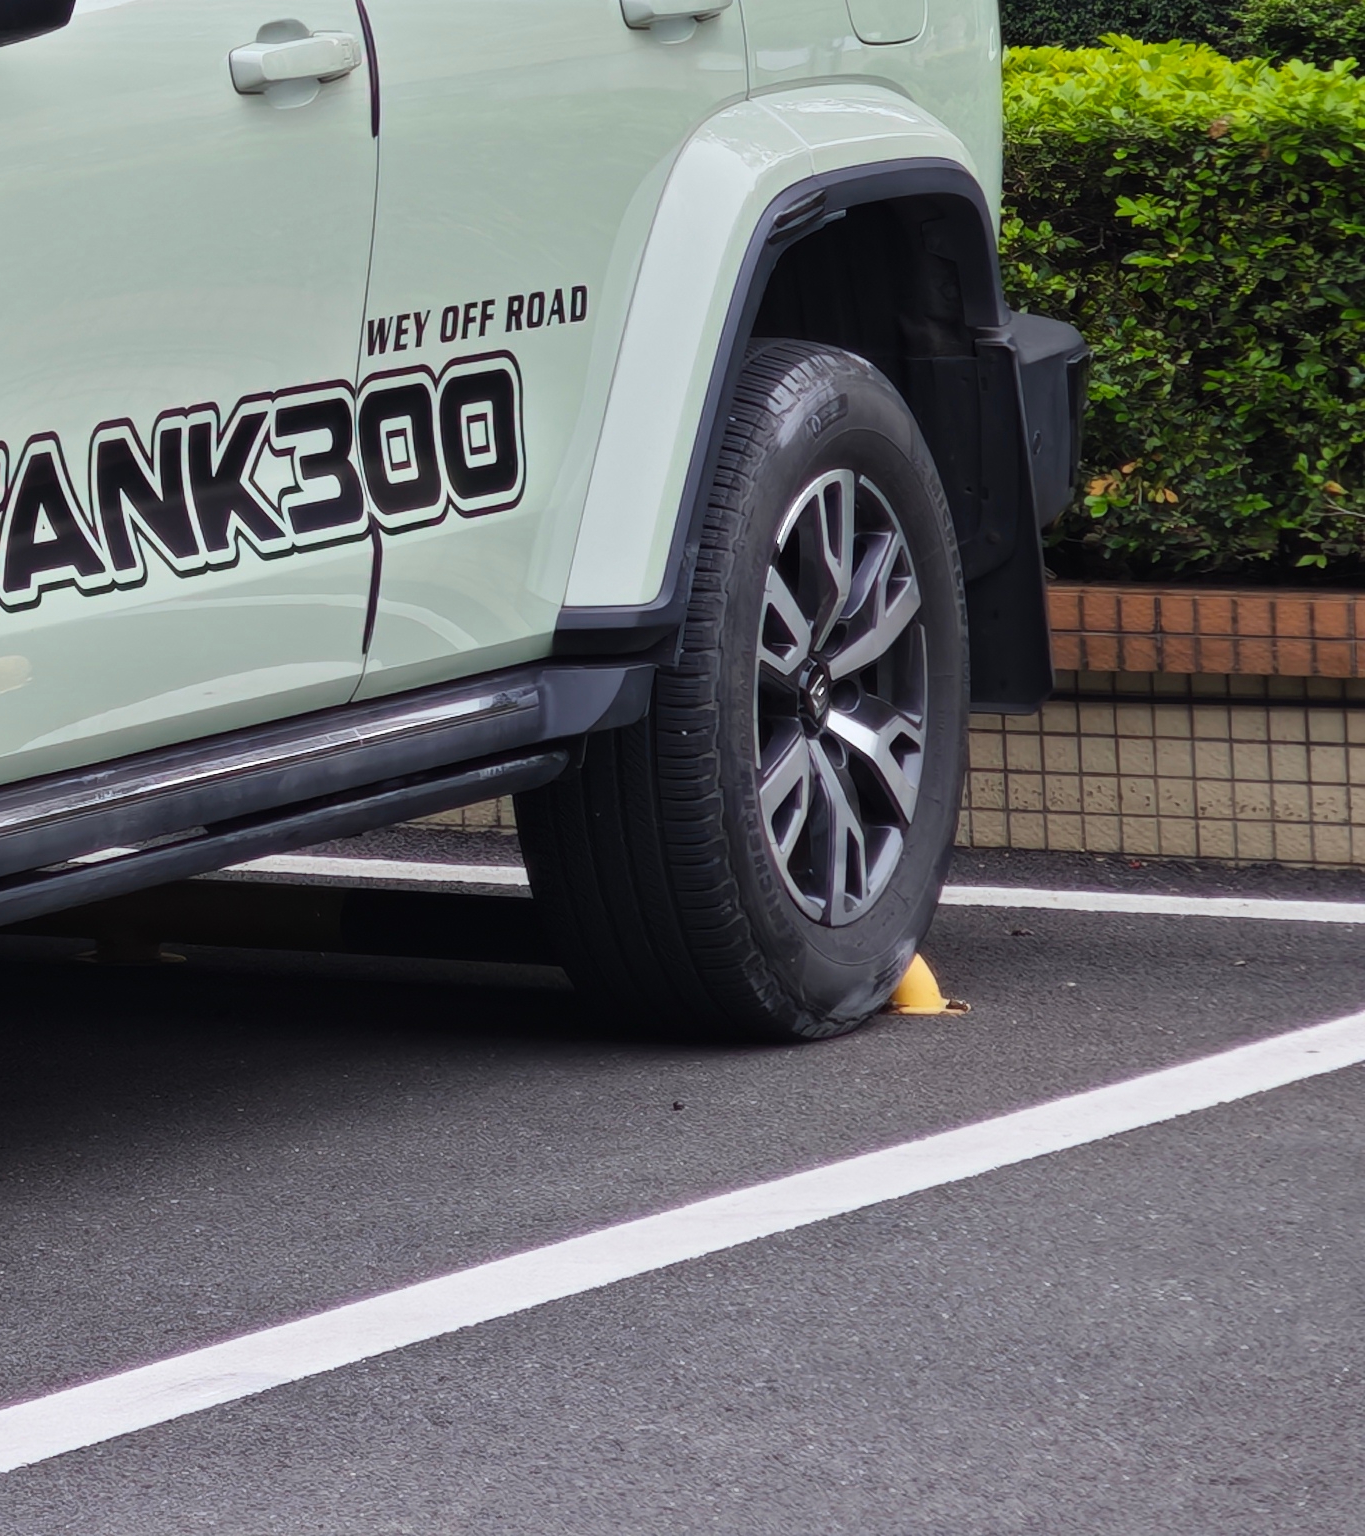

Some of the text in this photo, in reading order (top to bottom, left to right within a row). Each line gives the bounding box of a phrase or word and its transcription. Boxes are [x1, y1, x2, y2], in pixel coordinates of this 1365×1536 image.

[367, 284, 589, 357] WEY OFF ROAD
